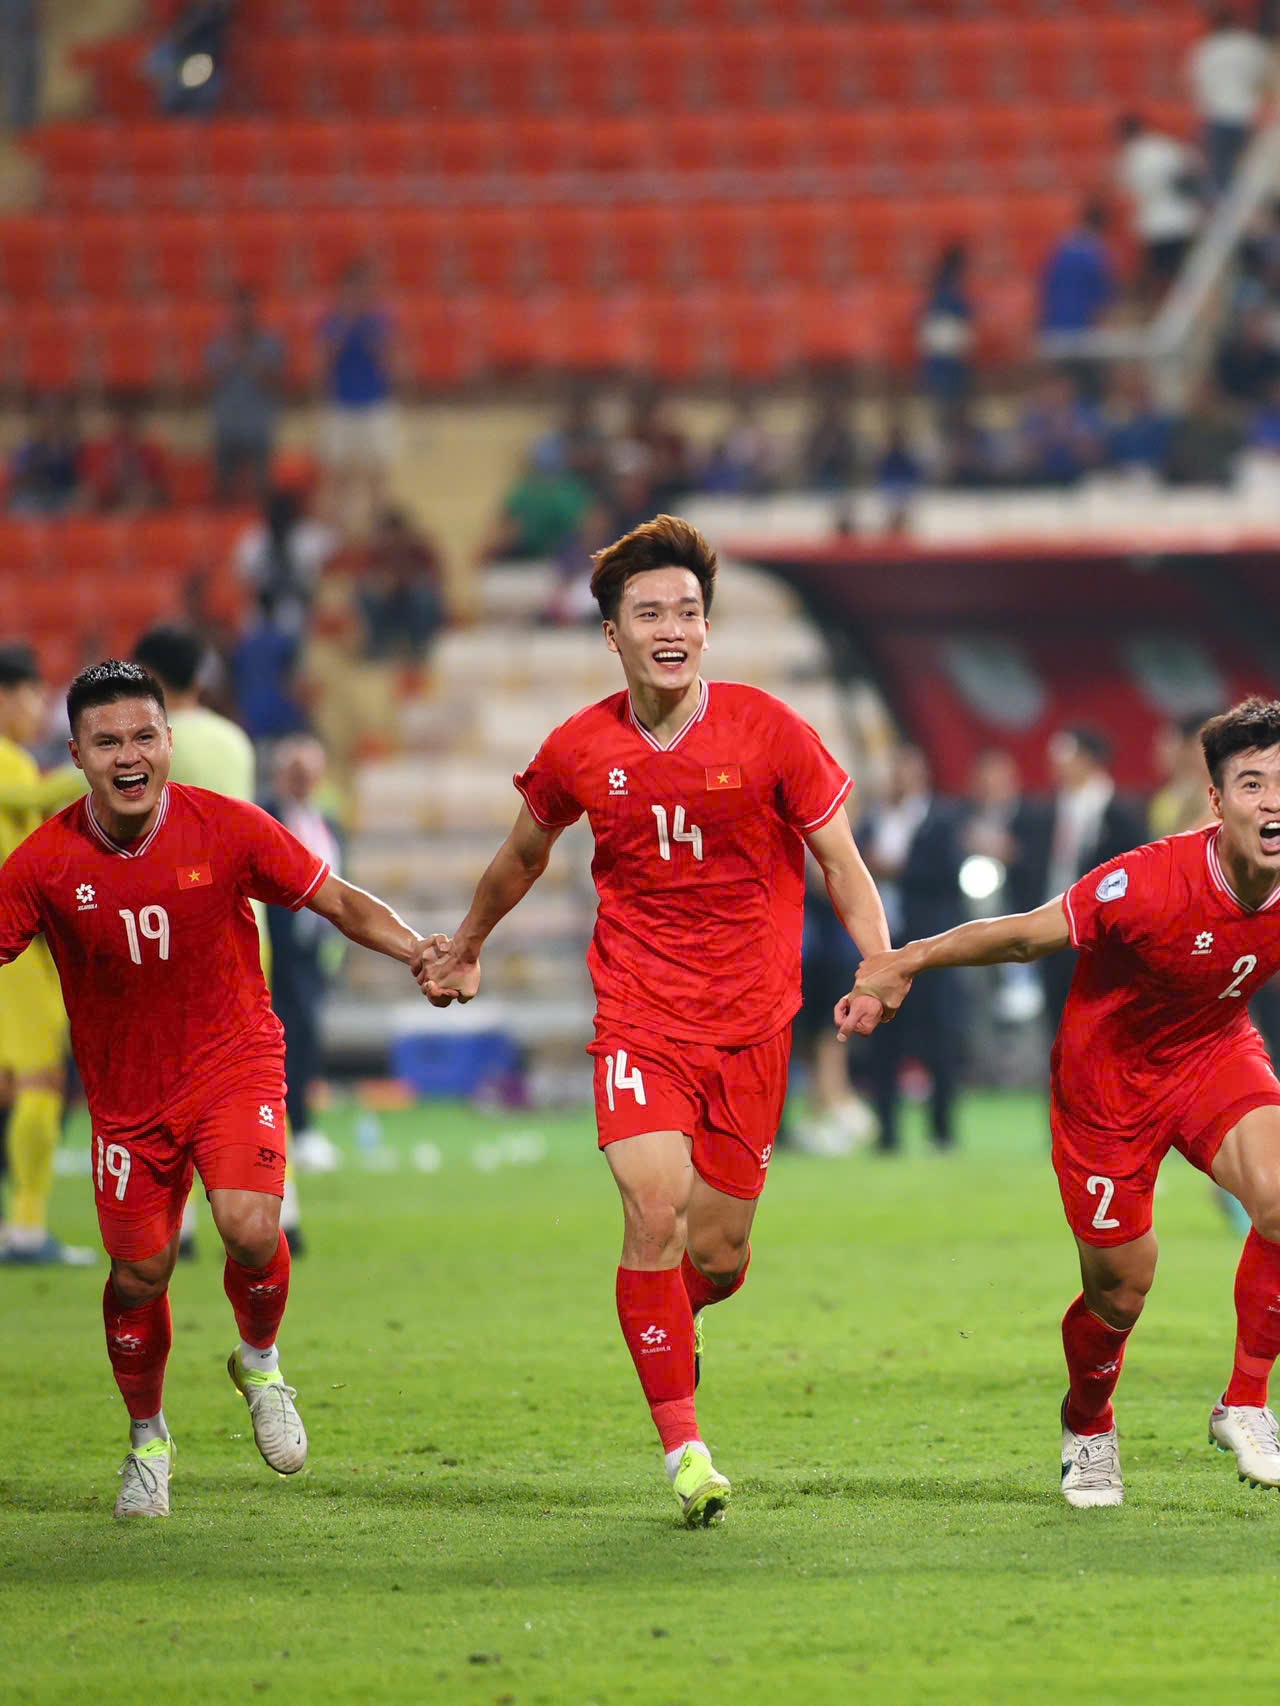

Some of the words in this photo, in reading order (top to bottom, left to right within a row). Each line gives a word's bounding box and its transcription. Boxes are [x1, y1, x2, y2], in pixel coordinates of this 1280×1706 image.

[652, 805, 702, 860] 14
[119, 905, 169, 964] 19
[1218, 955, 1257, 998] 2
[606, 1050, 646, 1111] 14
[97, 1136, 131, 1200] 19
[1087, 1176, 1119, 1228] 2
